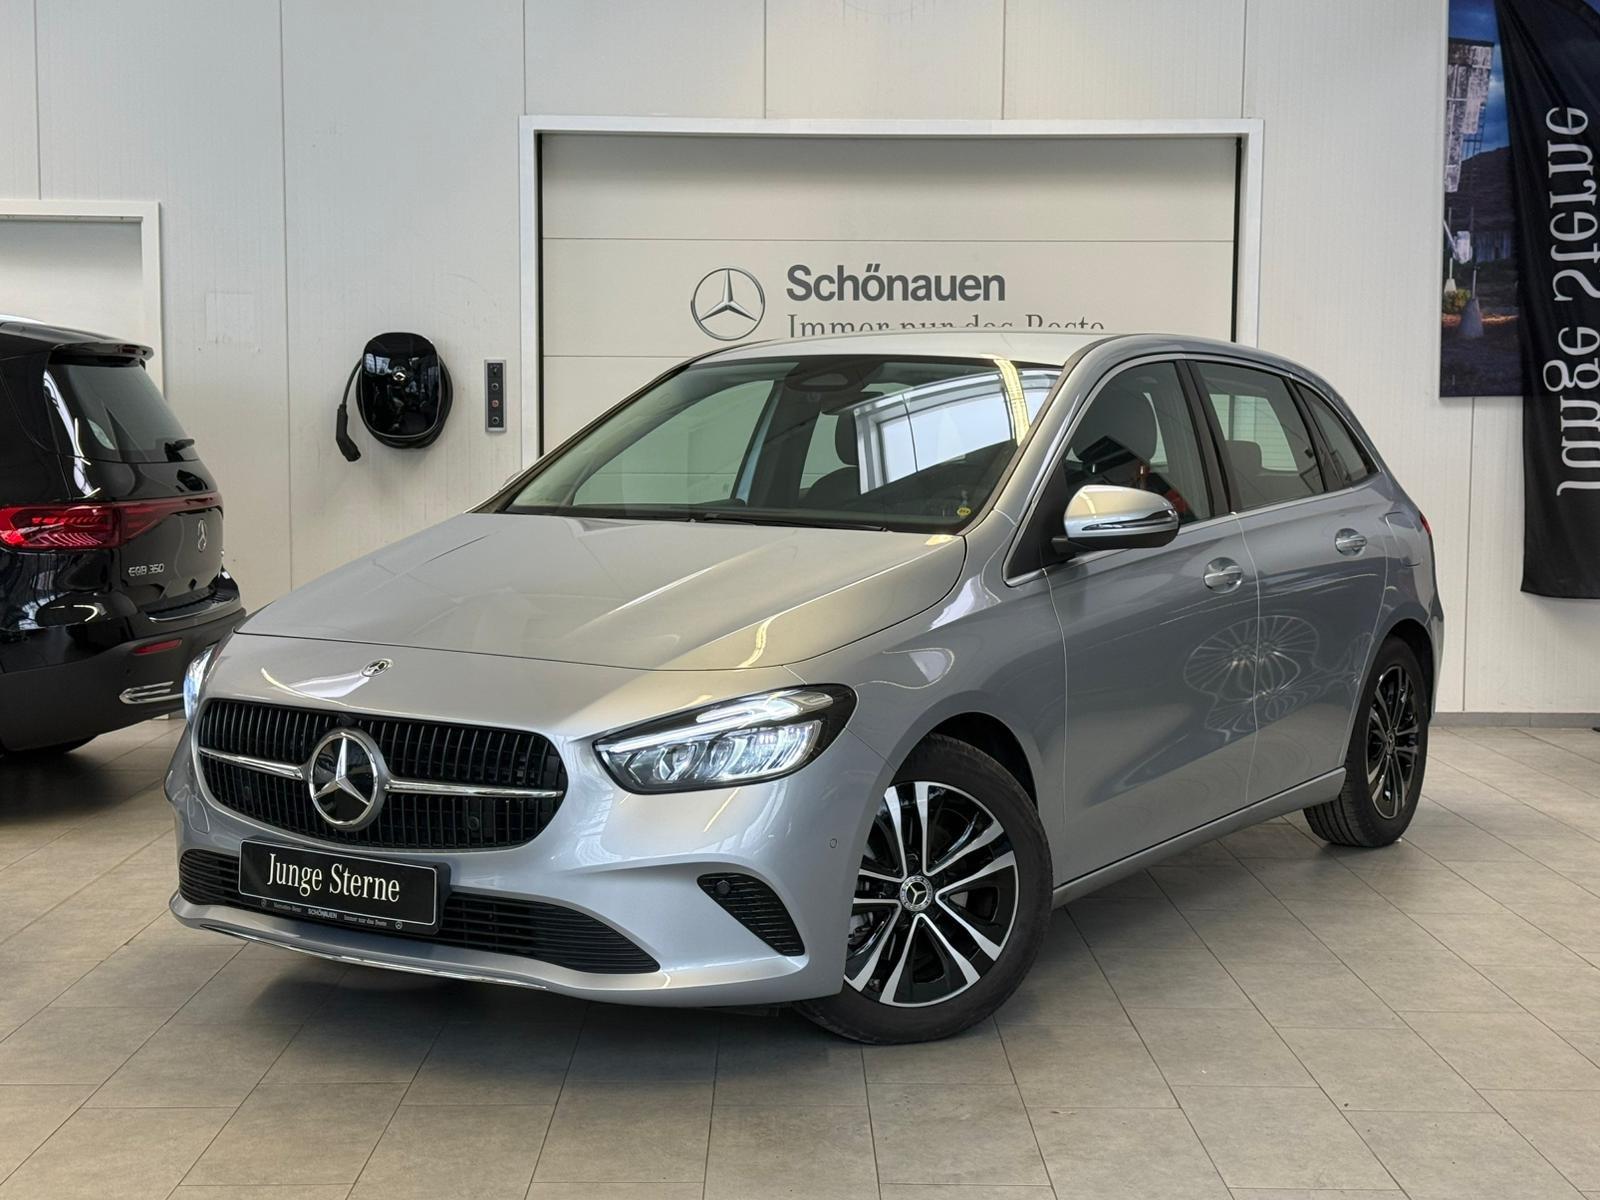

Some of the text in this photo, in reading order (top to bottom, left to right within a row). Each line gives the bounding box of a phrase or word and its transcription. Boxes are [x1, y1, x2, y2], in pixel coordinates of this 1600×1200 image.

[786, 263, 1006, 302] Schönauen
[128, 563, 165, 577] EQB 350
[266, 853, 400, 902] Junge Sterne
